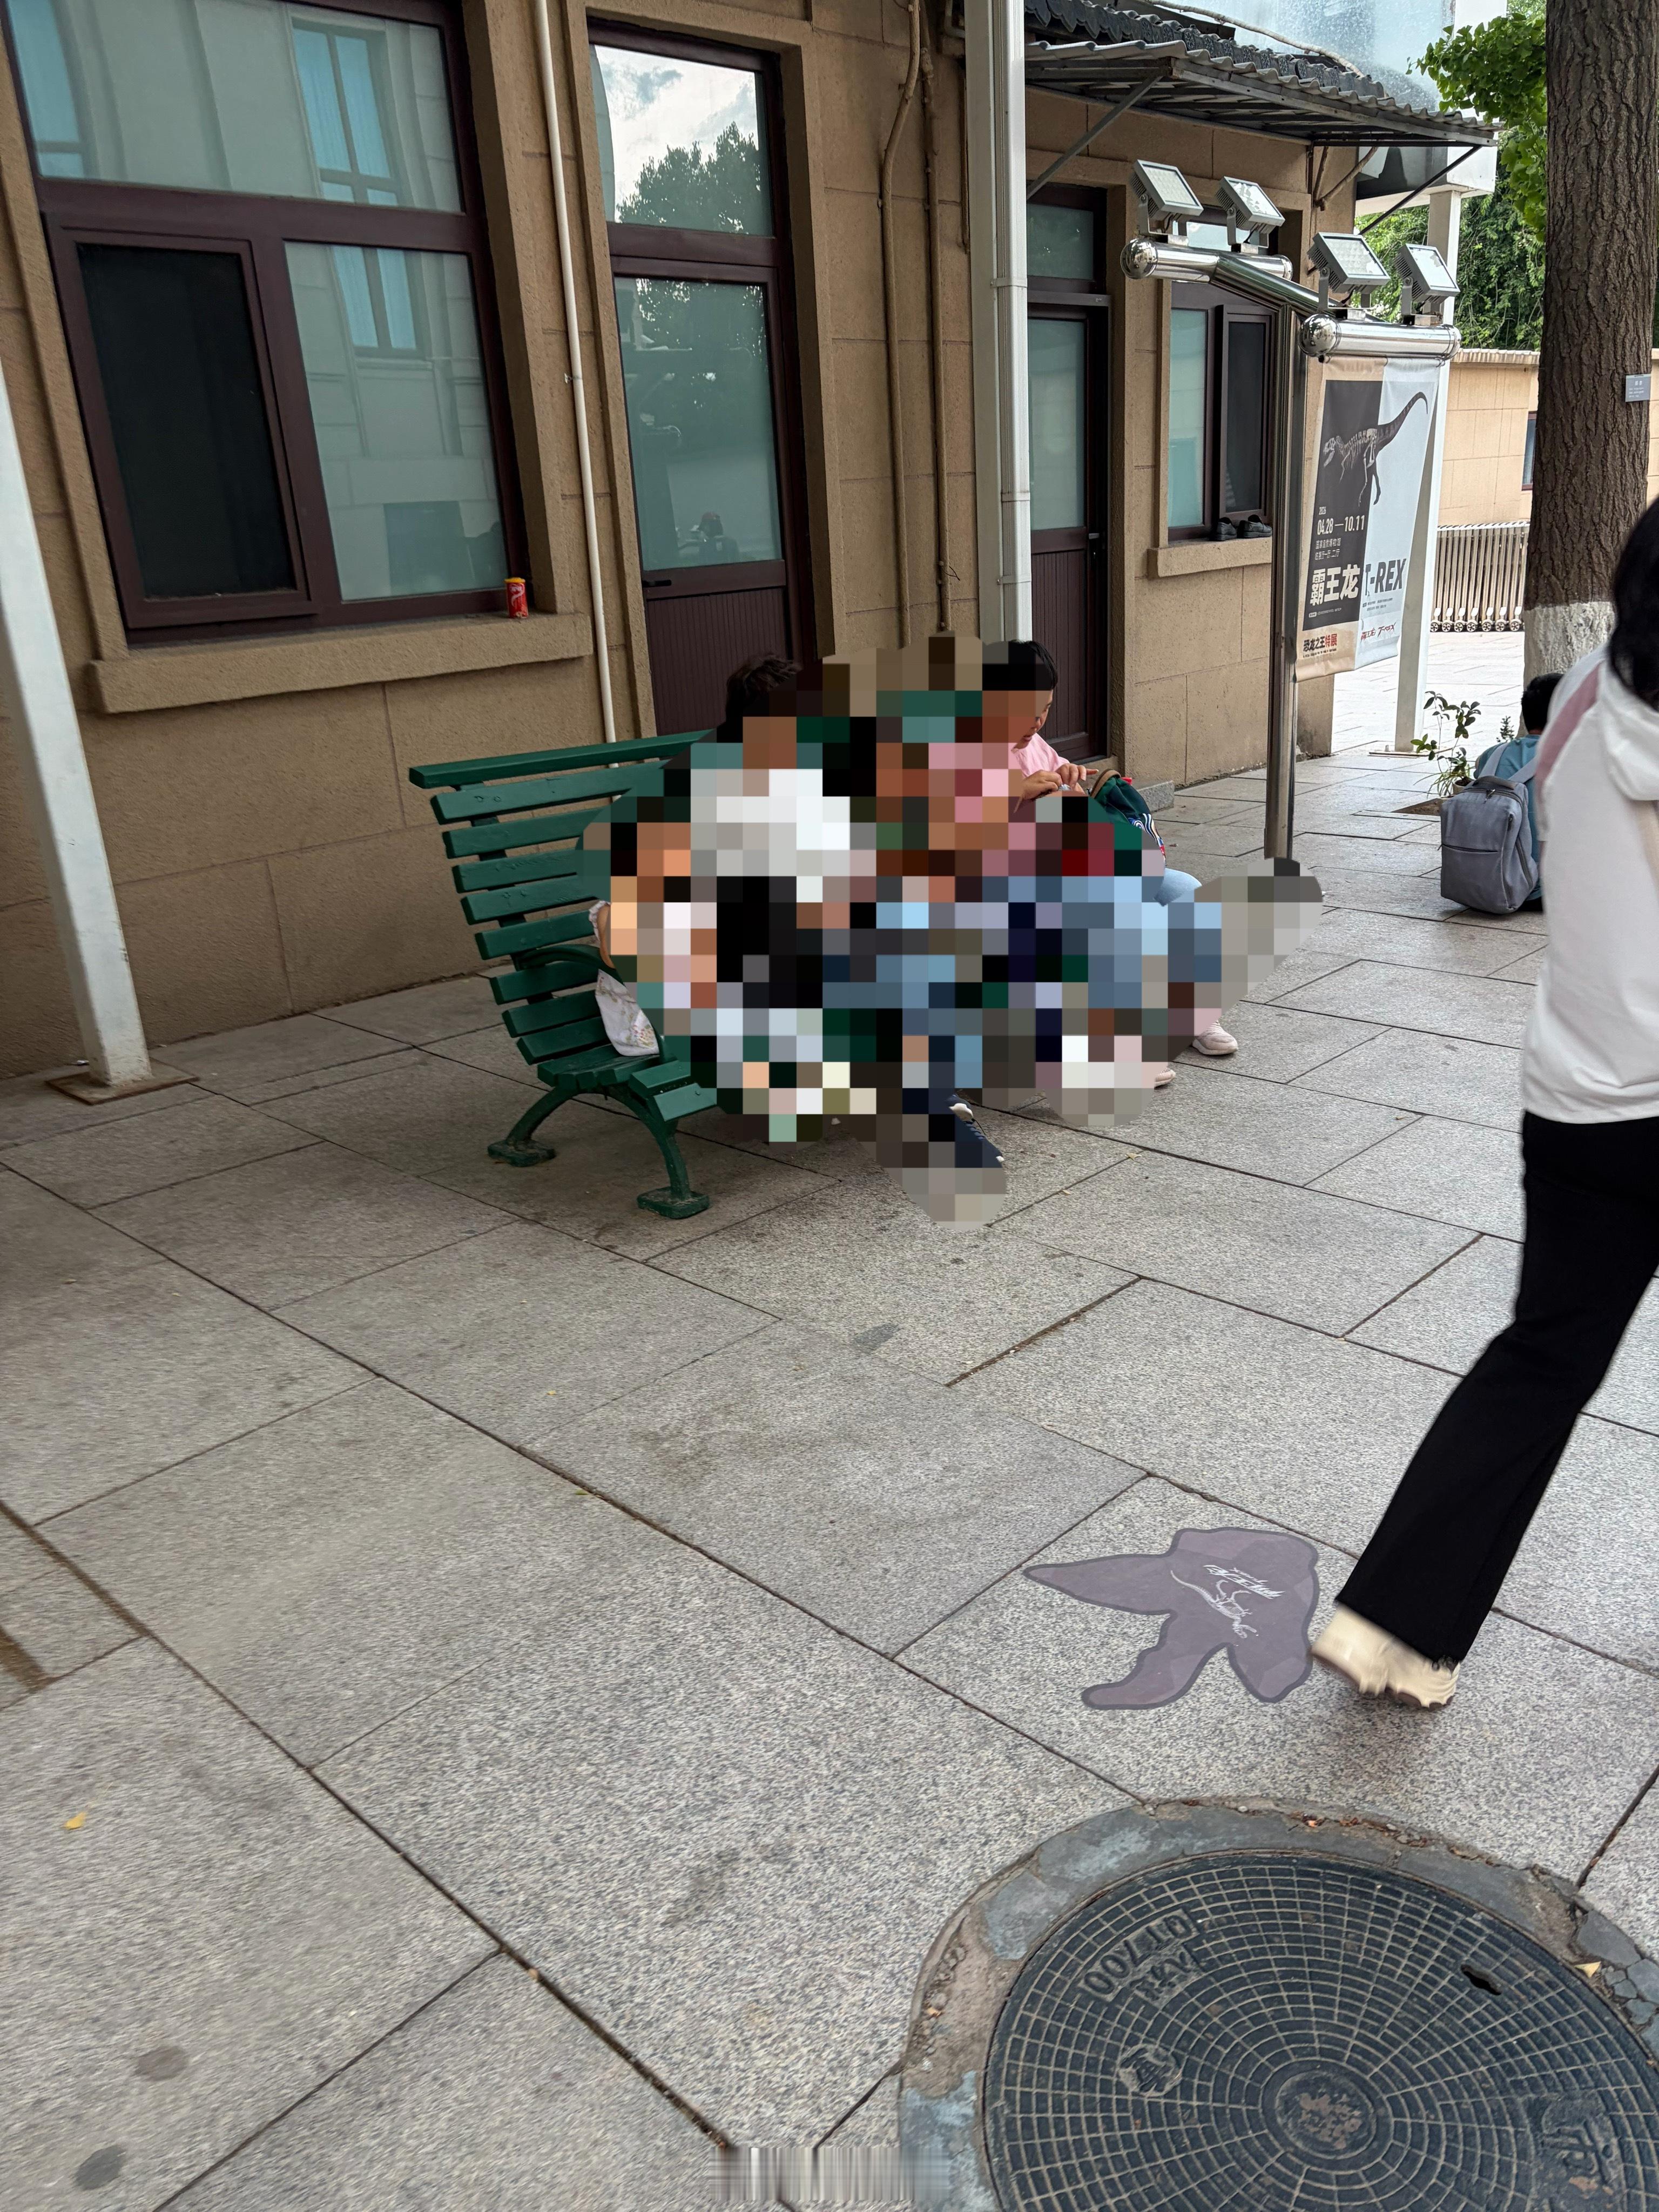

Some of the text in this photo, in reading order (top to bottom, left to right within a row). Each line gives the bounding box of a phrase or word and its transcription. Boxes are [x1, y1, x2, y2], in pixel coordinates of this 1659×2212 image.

[1310, 558, 1406, 606] 霸王龙 T-REX
[1303, 633, 1338, 652] 恐龙之王特展
